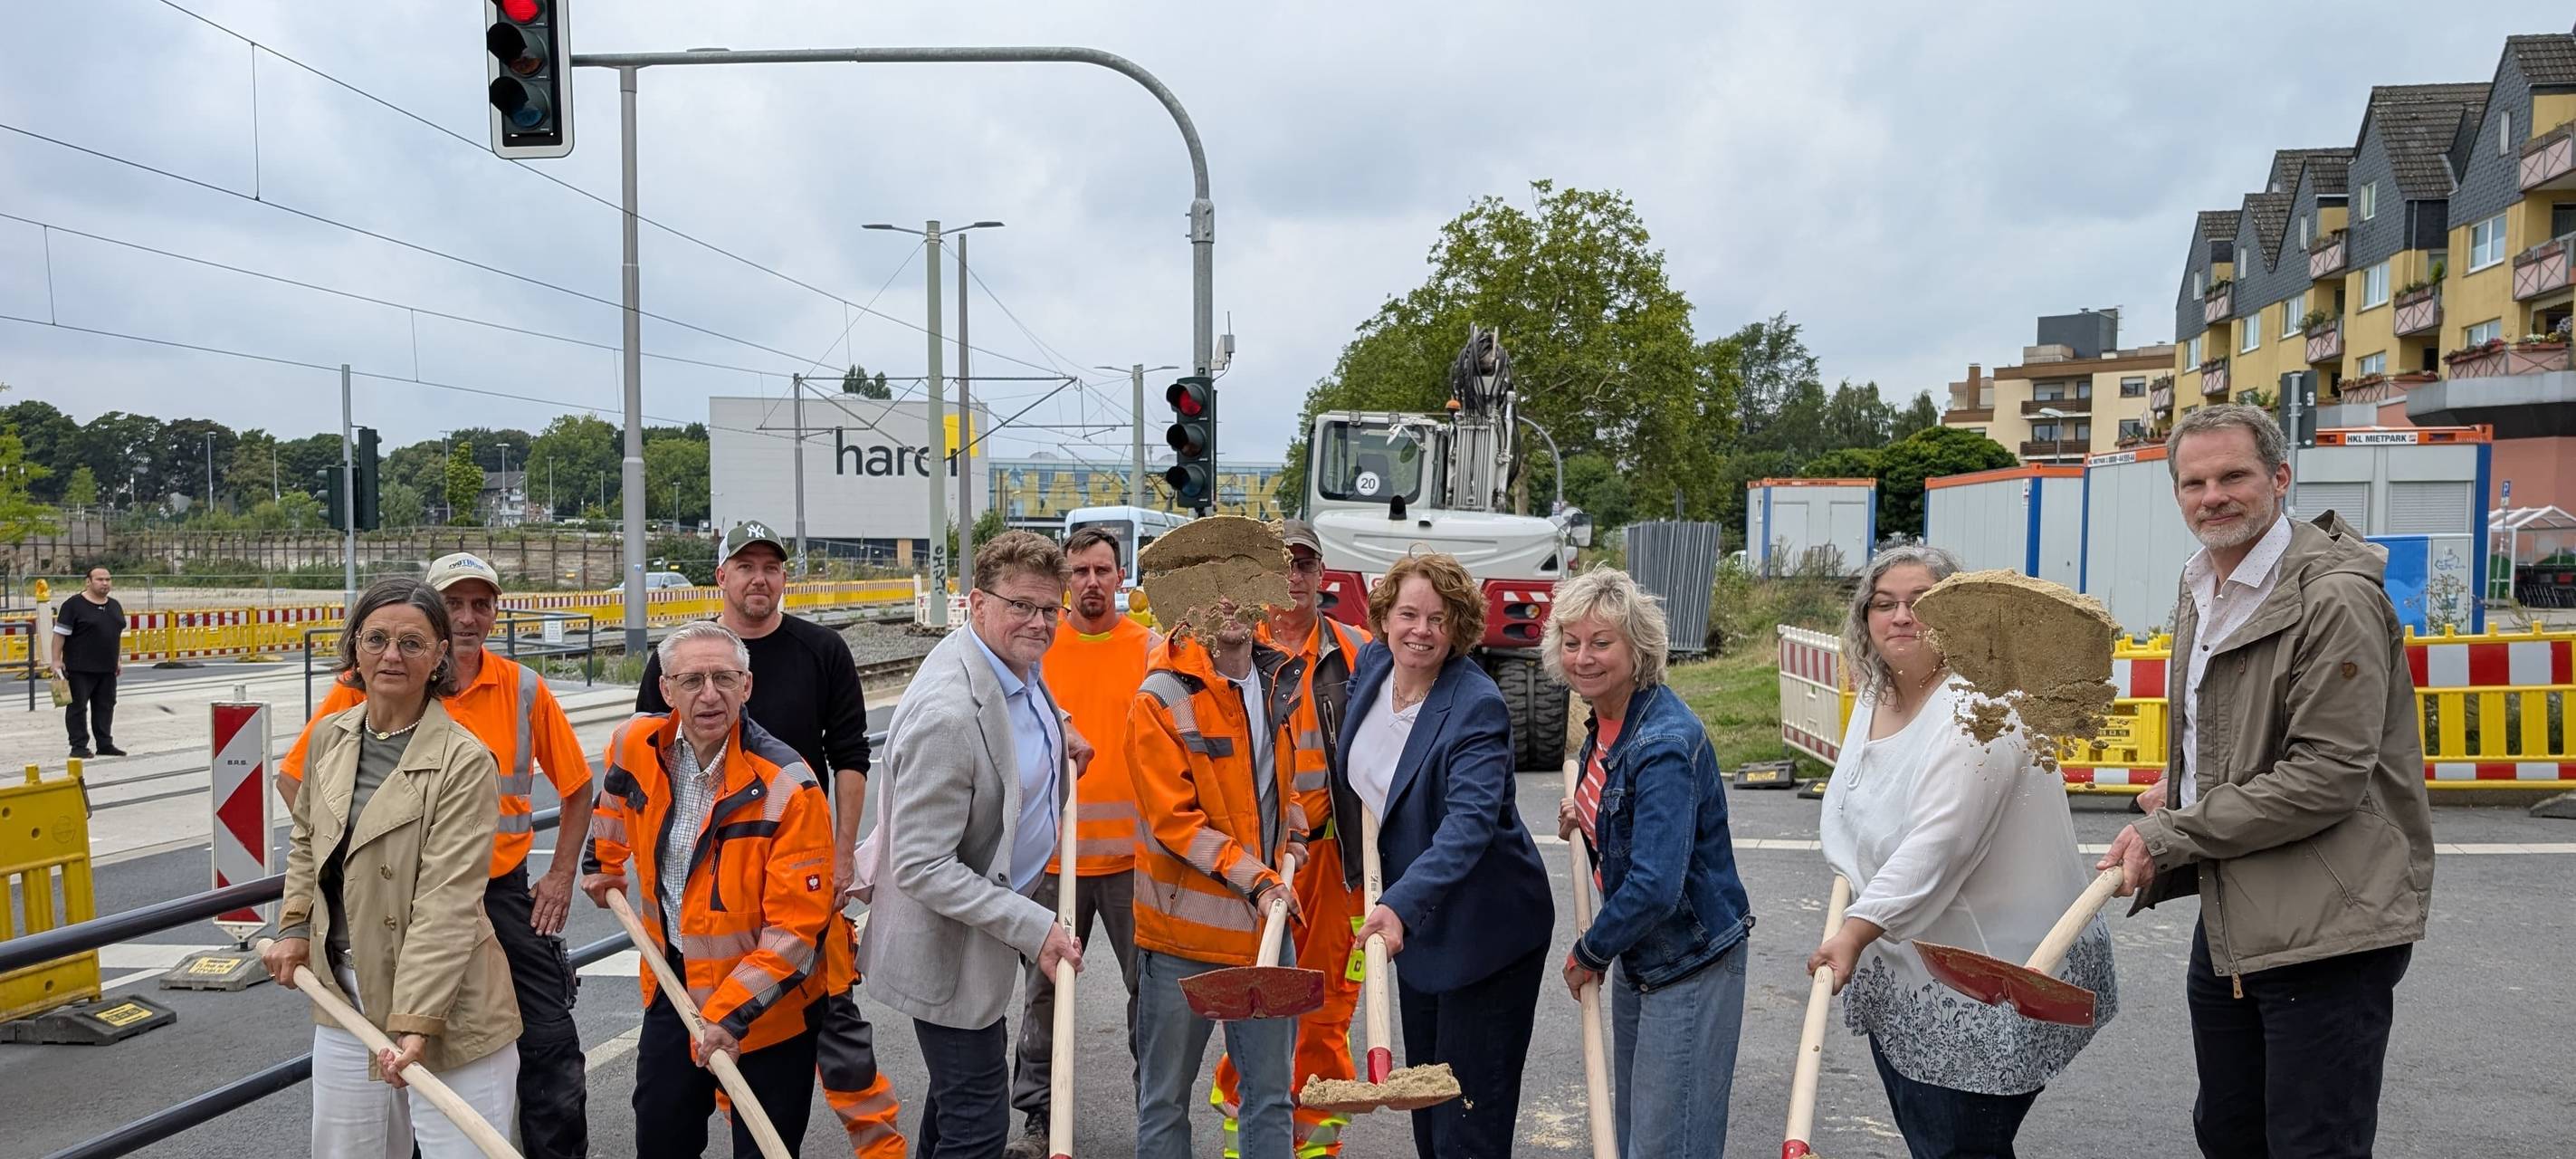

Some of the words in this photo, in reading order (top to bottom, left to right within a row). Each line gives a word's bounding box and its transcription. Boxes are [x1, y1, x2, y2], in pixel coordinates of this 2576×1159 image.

[2347, 435, 2362, 443] HKL
[2365, 434, 2407, 443] MIETPARK
[1360, 477, 1376, 490] 20
[995, 469, 1285, 520] HARDCK
[747, 524, 766, 539] NY
